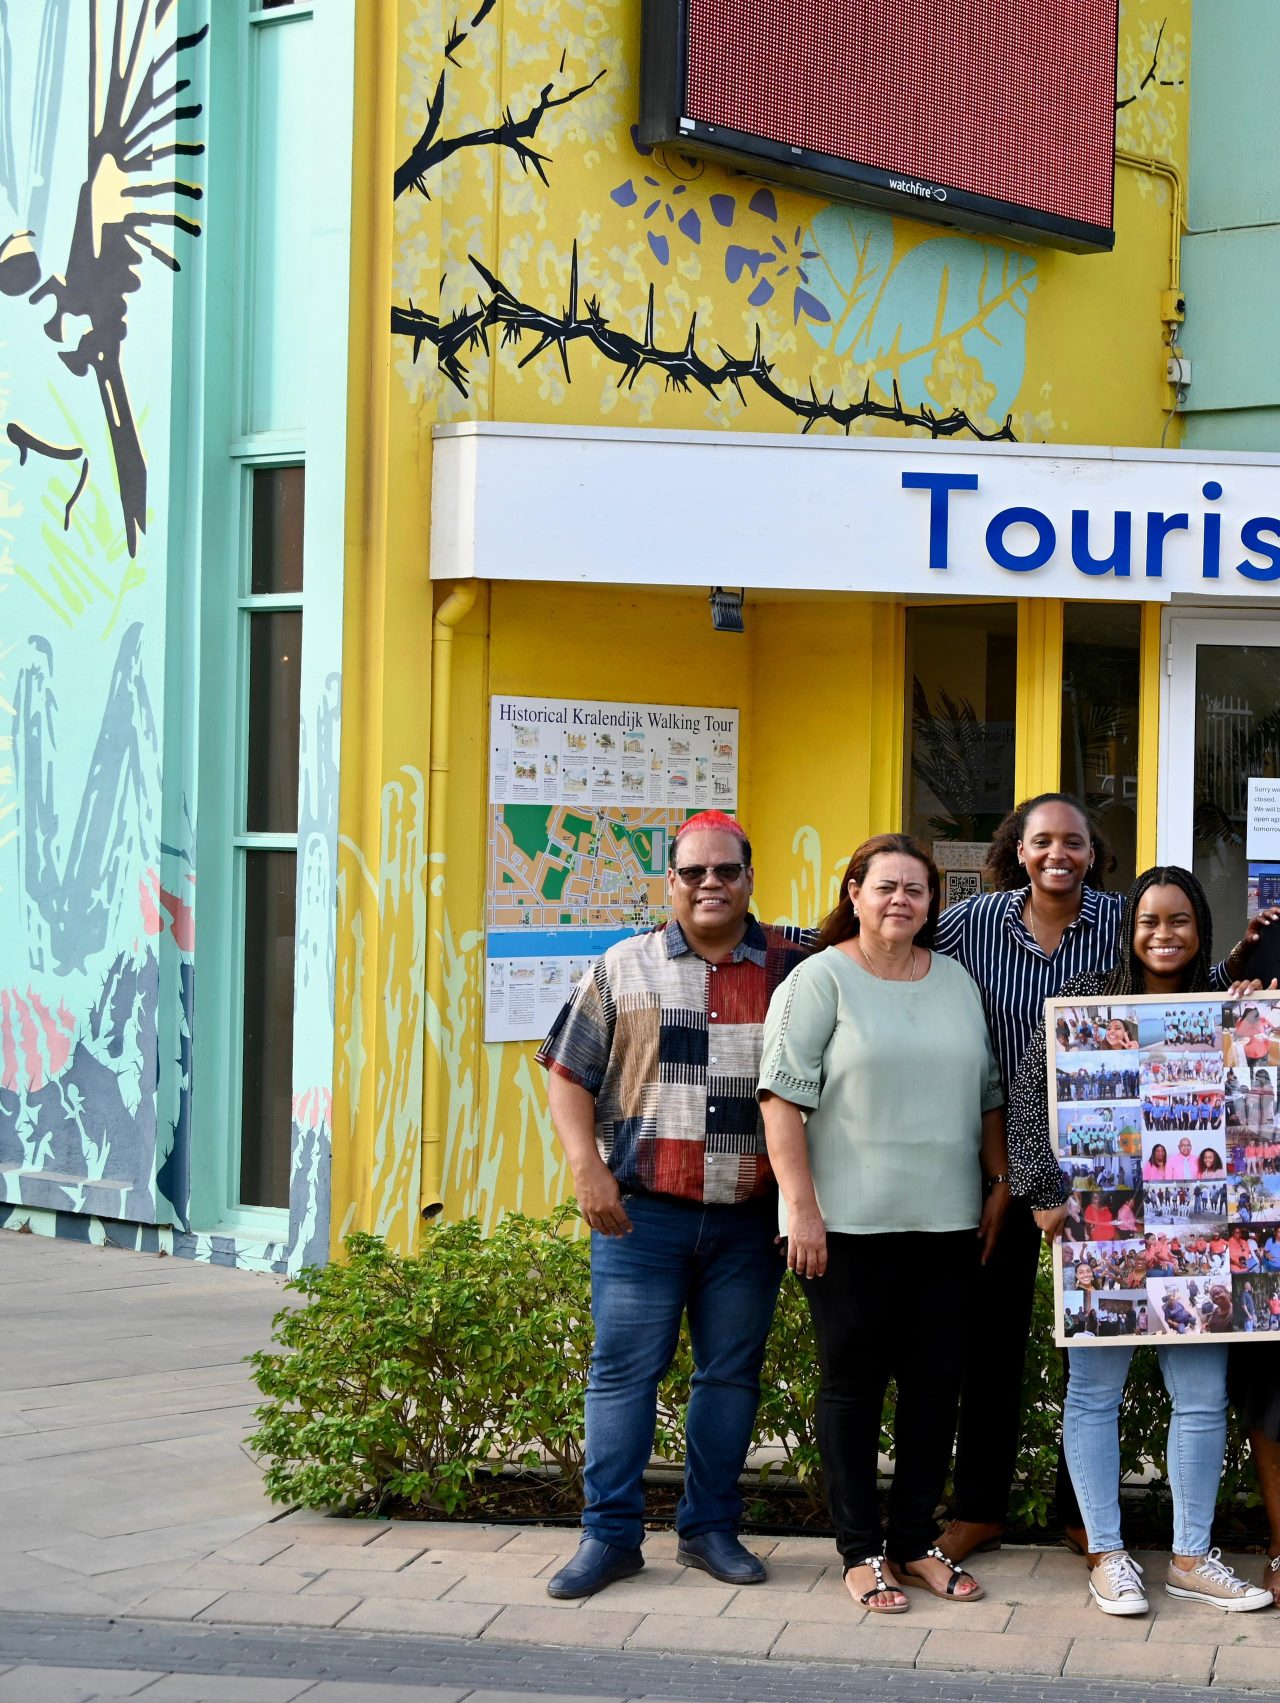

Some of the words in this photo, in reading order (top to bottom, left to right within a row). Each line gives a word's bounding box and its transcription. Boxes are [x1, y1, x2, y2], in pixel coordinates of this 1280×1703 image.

[889, 178, 931, 199] watchfire
[500, 703, 568, 724] Historical
[572, 707, 643, 732] Kralendijk
[647, 712, 701, 735] Walking
[704, 715, 734, 733] Tour
